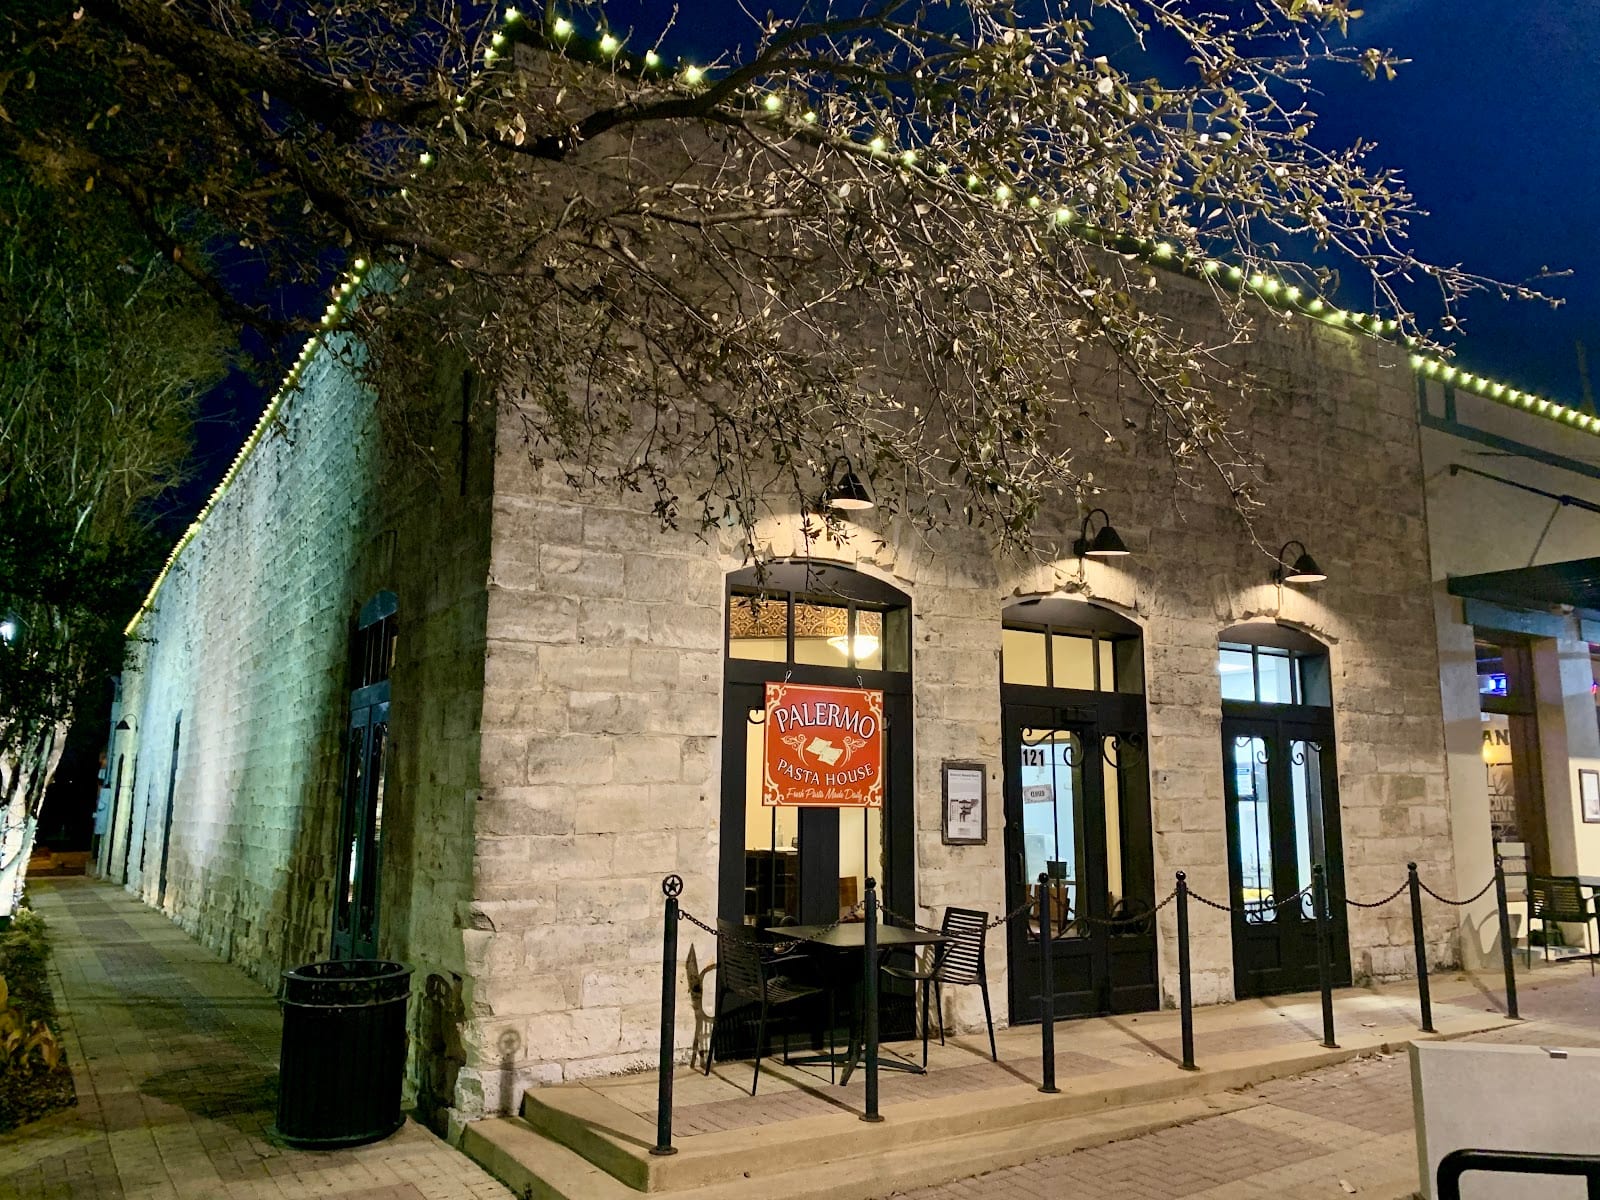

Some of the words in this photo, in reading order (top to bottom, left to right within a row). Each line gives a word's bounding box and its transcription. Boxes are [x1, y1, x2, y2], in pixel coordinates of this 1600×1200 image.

[774, 702, 875, 739] PALERMO
[777, 758, 820, 785] PASTA
[826, 763, 874, 786] HOUSE
[1023, 749, 1044, 767] 121
